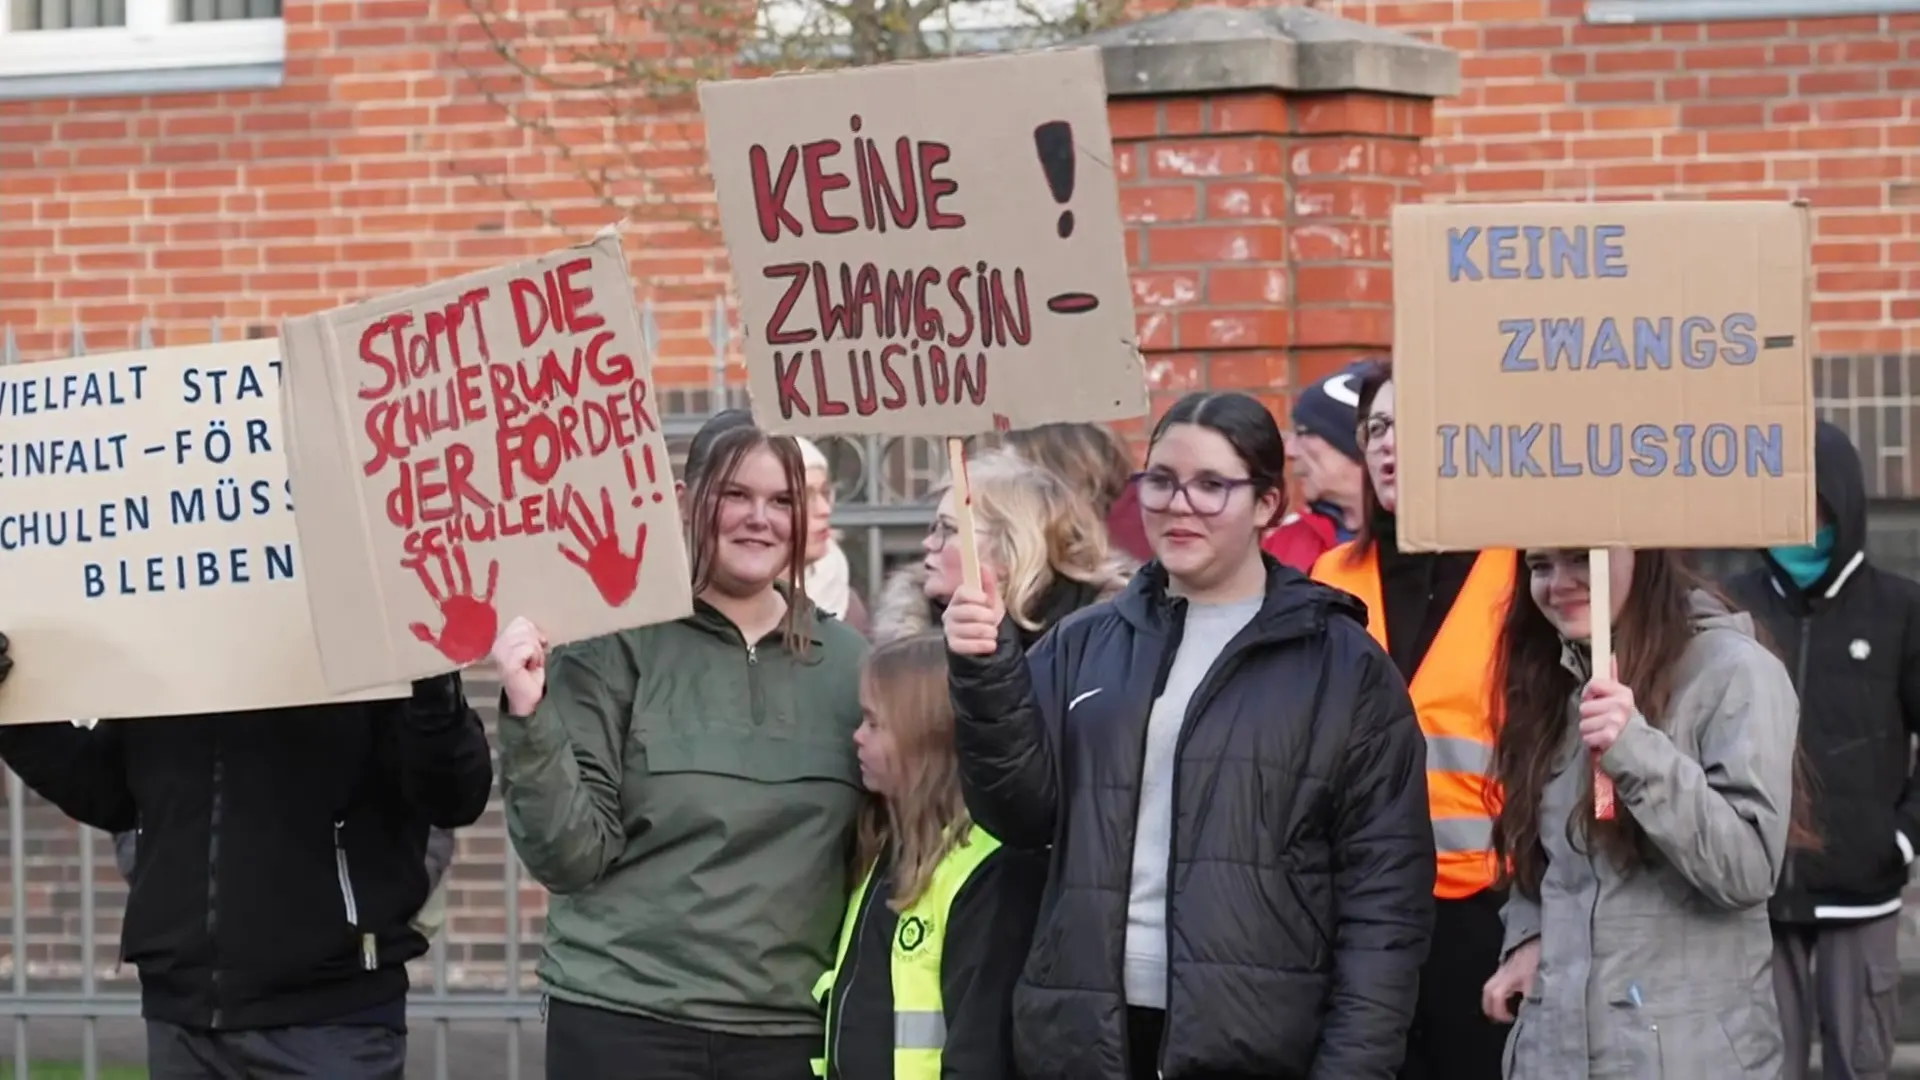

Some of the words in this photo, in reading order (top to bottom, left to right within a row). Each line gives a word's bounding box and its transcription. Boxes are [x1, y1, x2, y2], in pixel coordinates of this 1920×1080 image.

[1447, 225, 1629, 282] KEINE
[508, 257, 605, 348] DIE
[1499, 313, 1795, 373] ZWANGS-
[1437, 422, 1784, 478] INKLUSION
[84, 544, 294, 598] BLEIBEN
